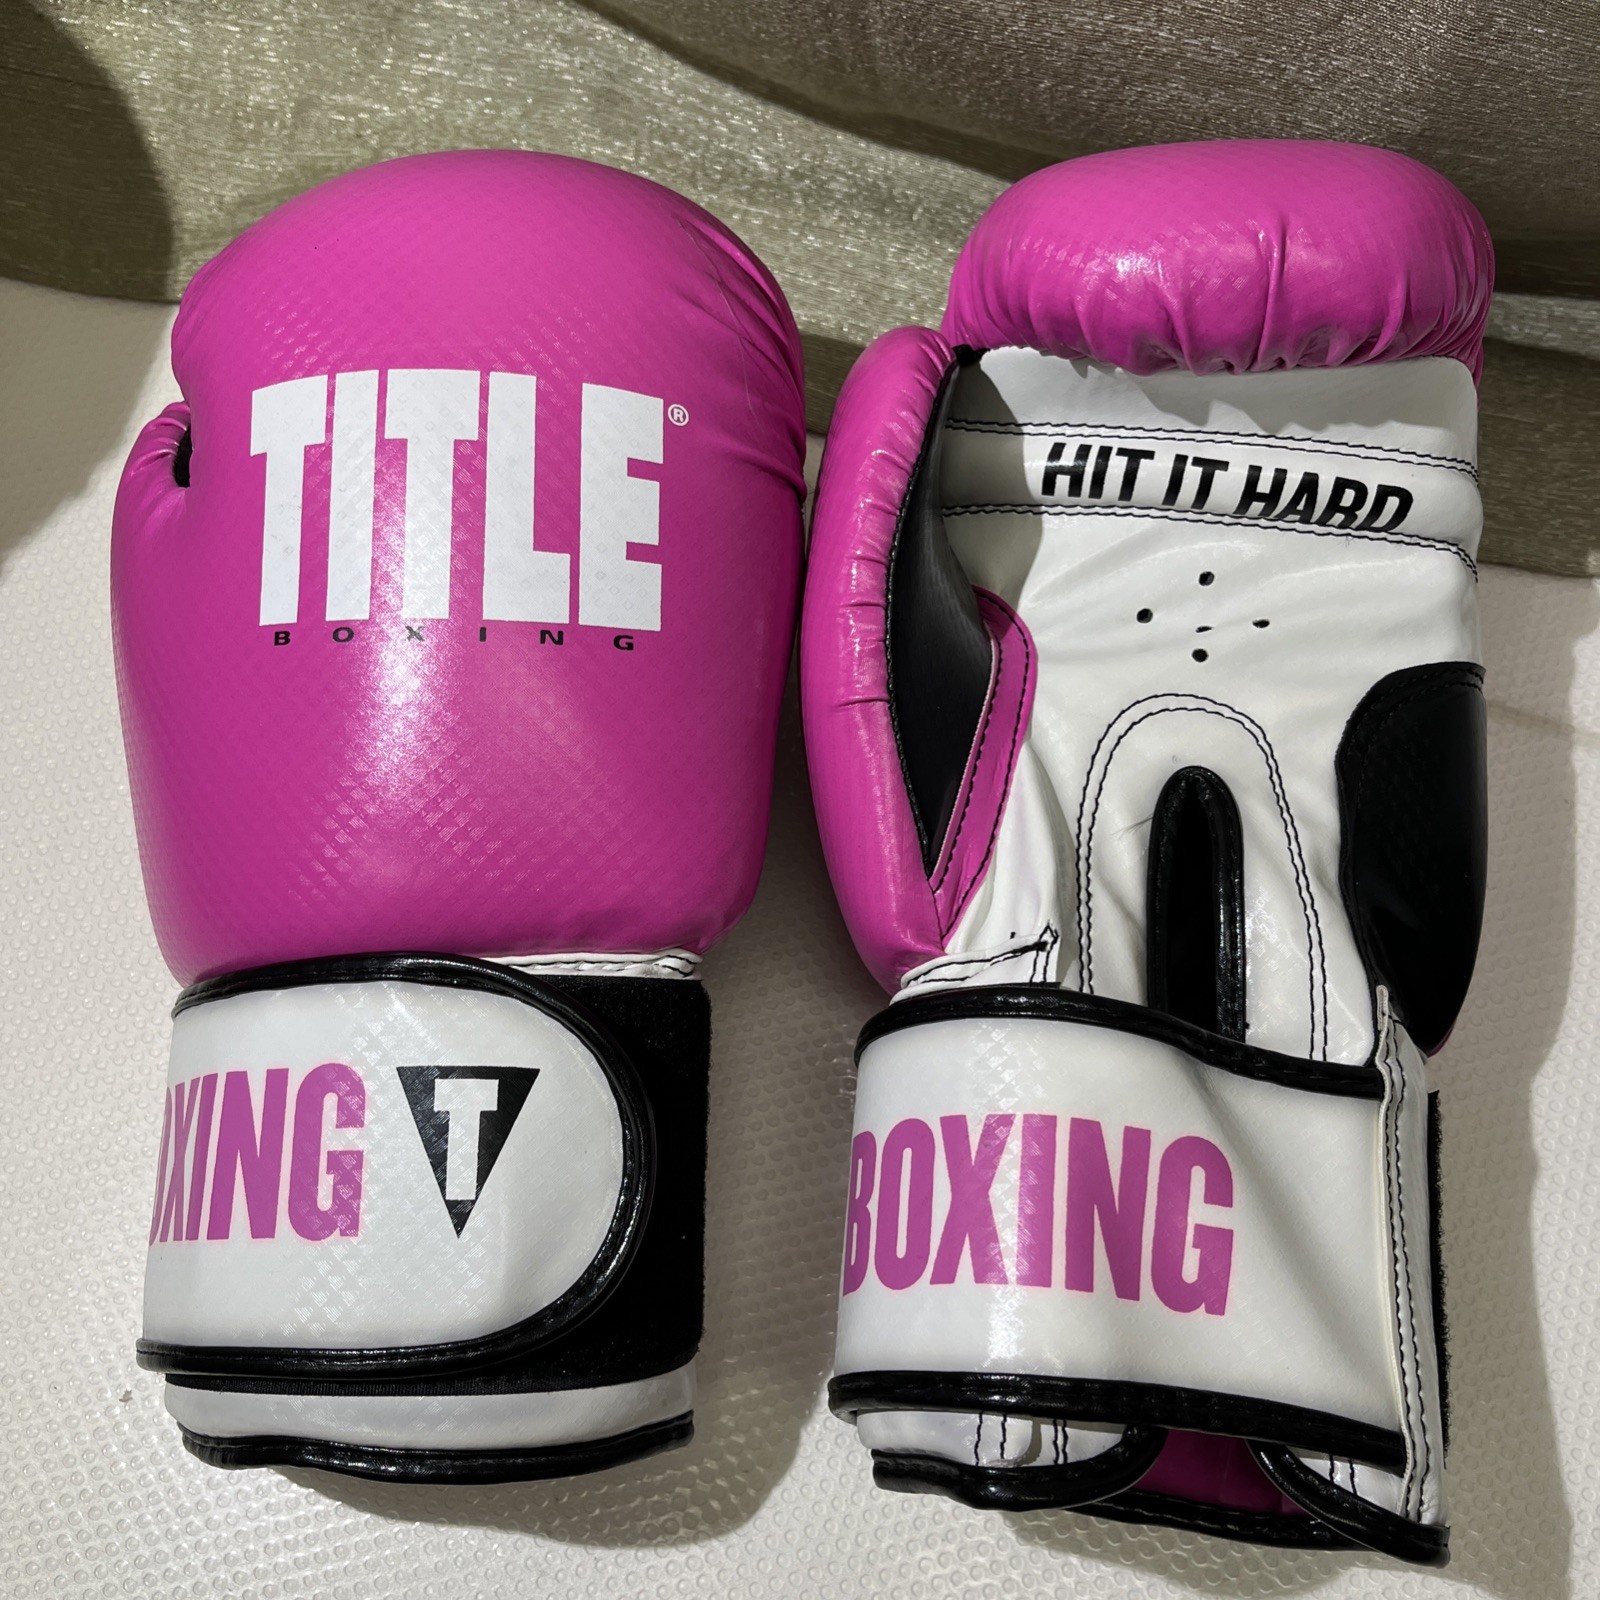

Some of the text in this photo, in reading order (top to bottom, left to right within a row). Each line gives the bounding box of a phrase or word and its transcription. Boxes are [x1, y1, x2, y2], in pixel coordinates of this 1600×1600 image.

[1041, 442, 1414, 533] HIT IT HARD
[273, 625, 635, 652] BOXING
[434, 1078, 500, 1201] T
[843, 1113, 1234, 1317] BOXING
